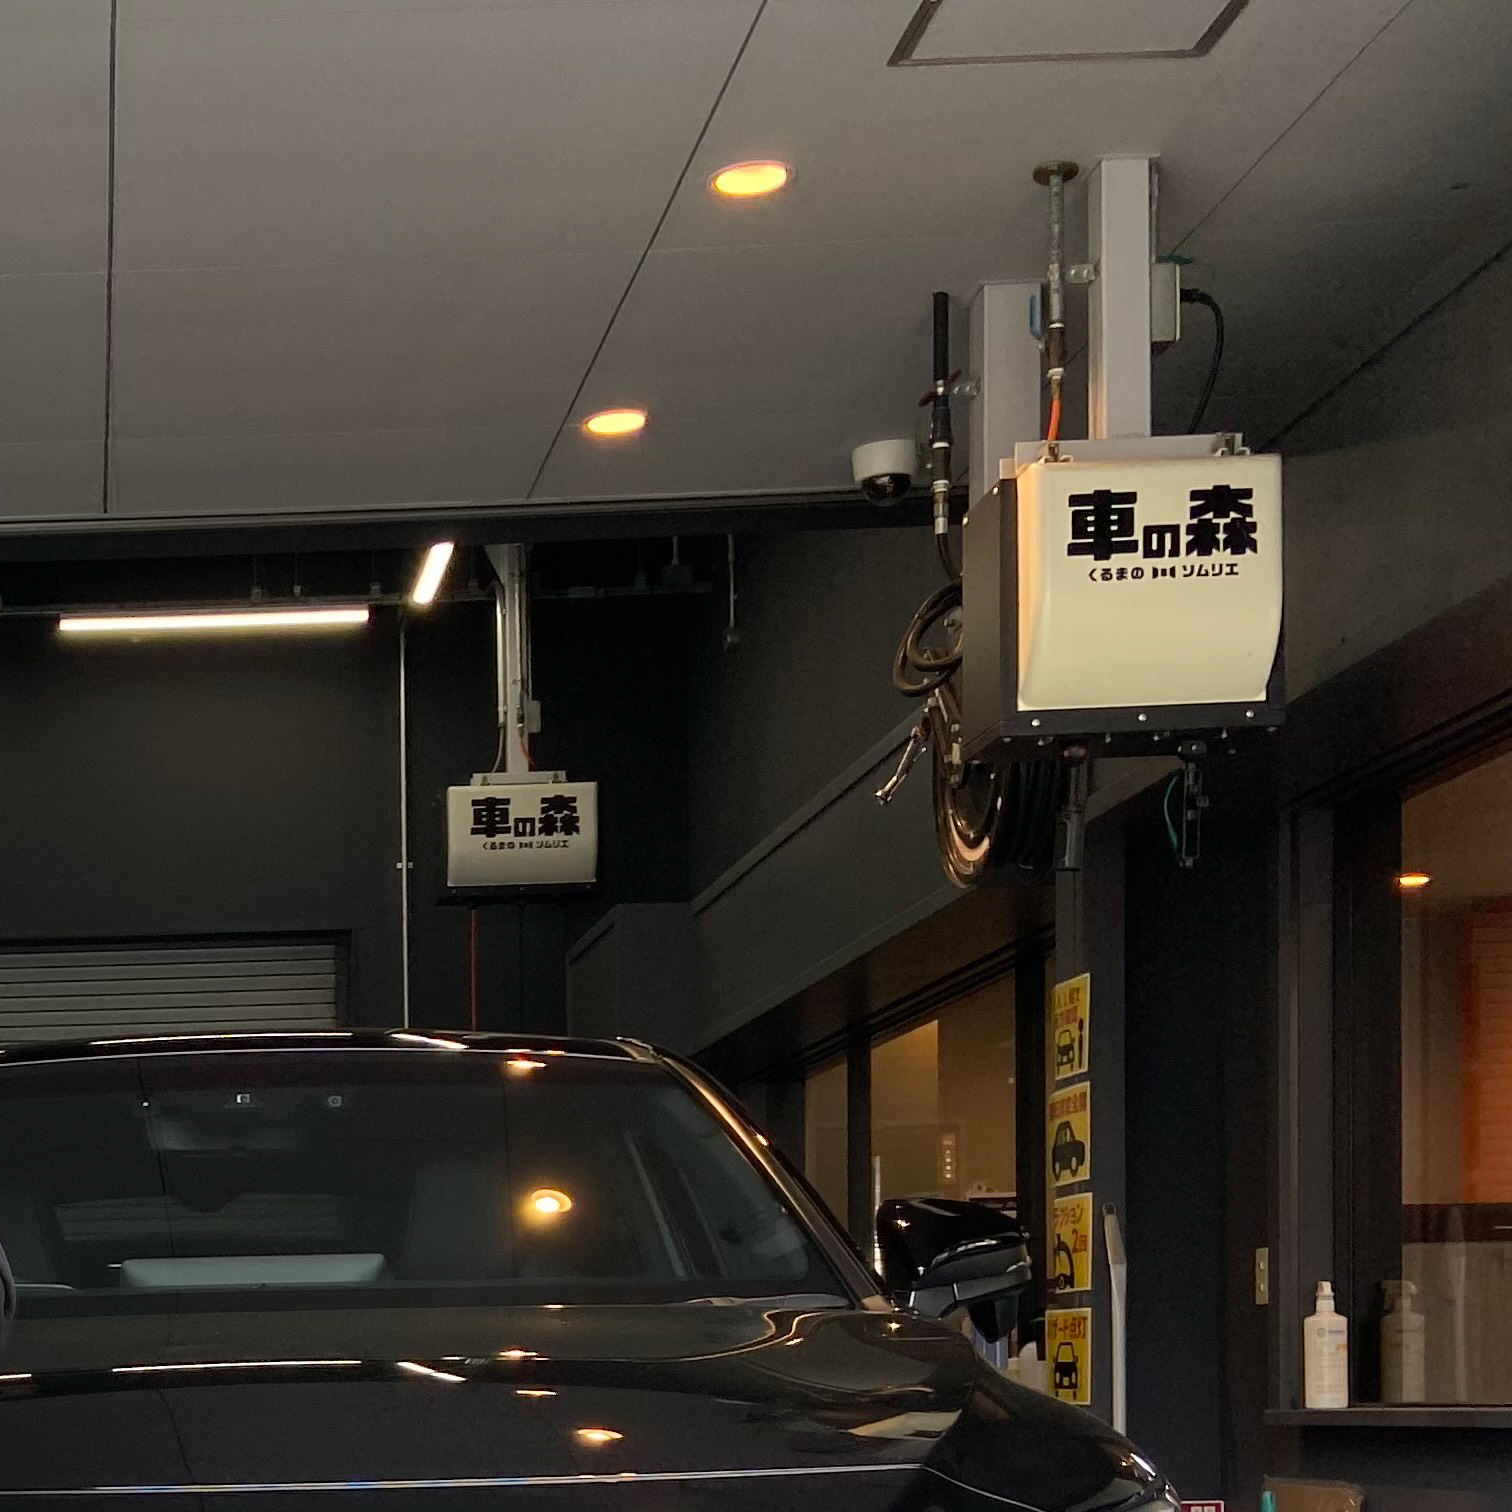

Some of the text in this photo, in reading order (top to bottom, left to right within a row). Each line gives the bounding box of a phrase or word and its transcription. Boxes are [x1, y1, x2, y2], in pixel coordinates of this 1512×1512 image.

[1067, 485, 1258, 561] 車の森
[1088, 563, 1239, 582] くるまの ソムリエ
[470, 795, 580, 838] 車の森
